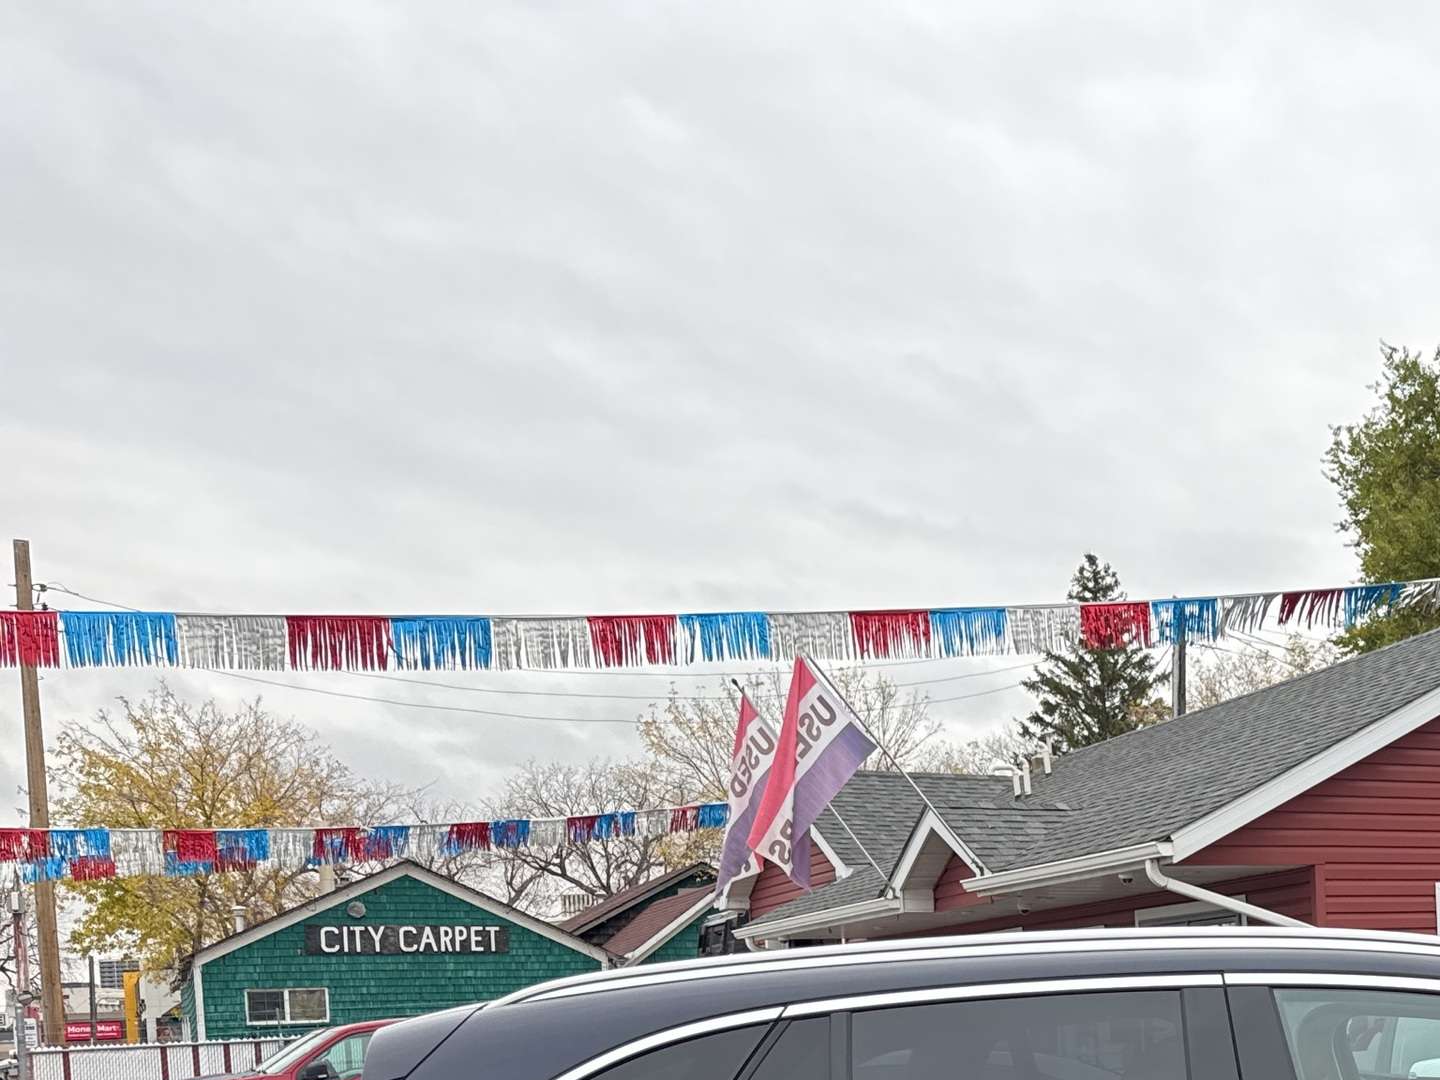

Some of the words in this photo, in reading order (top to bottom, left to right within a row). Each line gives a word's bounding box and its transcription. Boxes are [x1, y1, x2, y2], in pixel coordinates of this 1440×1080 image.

[320, 925, 385, 953] CITY
[398, 925, 500, 953] CARPET
[66, 1025, 92, 1034] Mone
